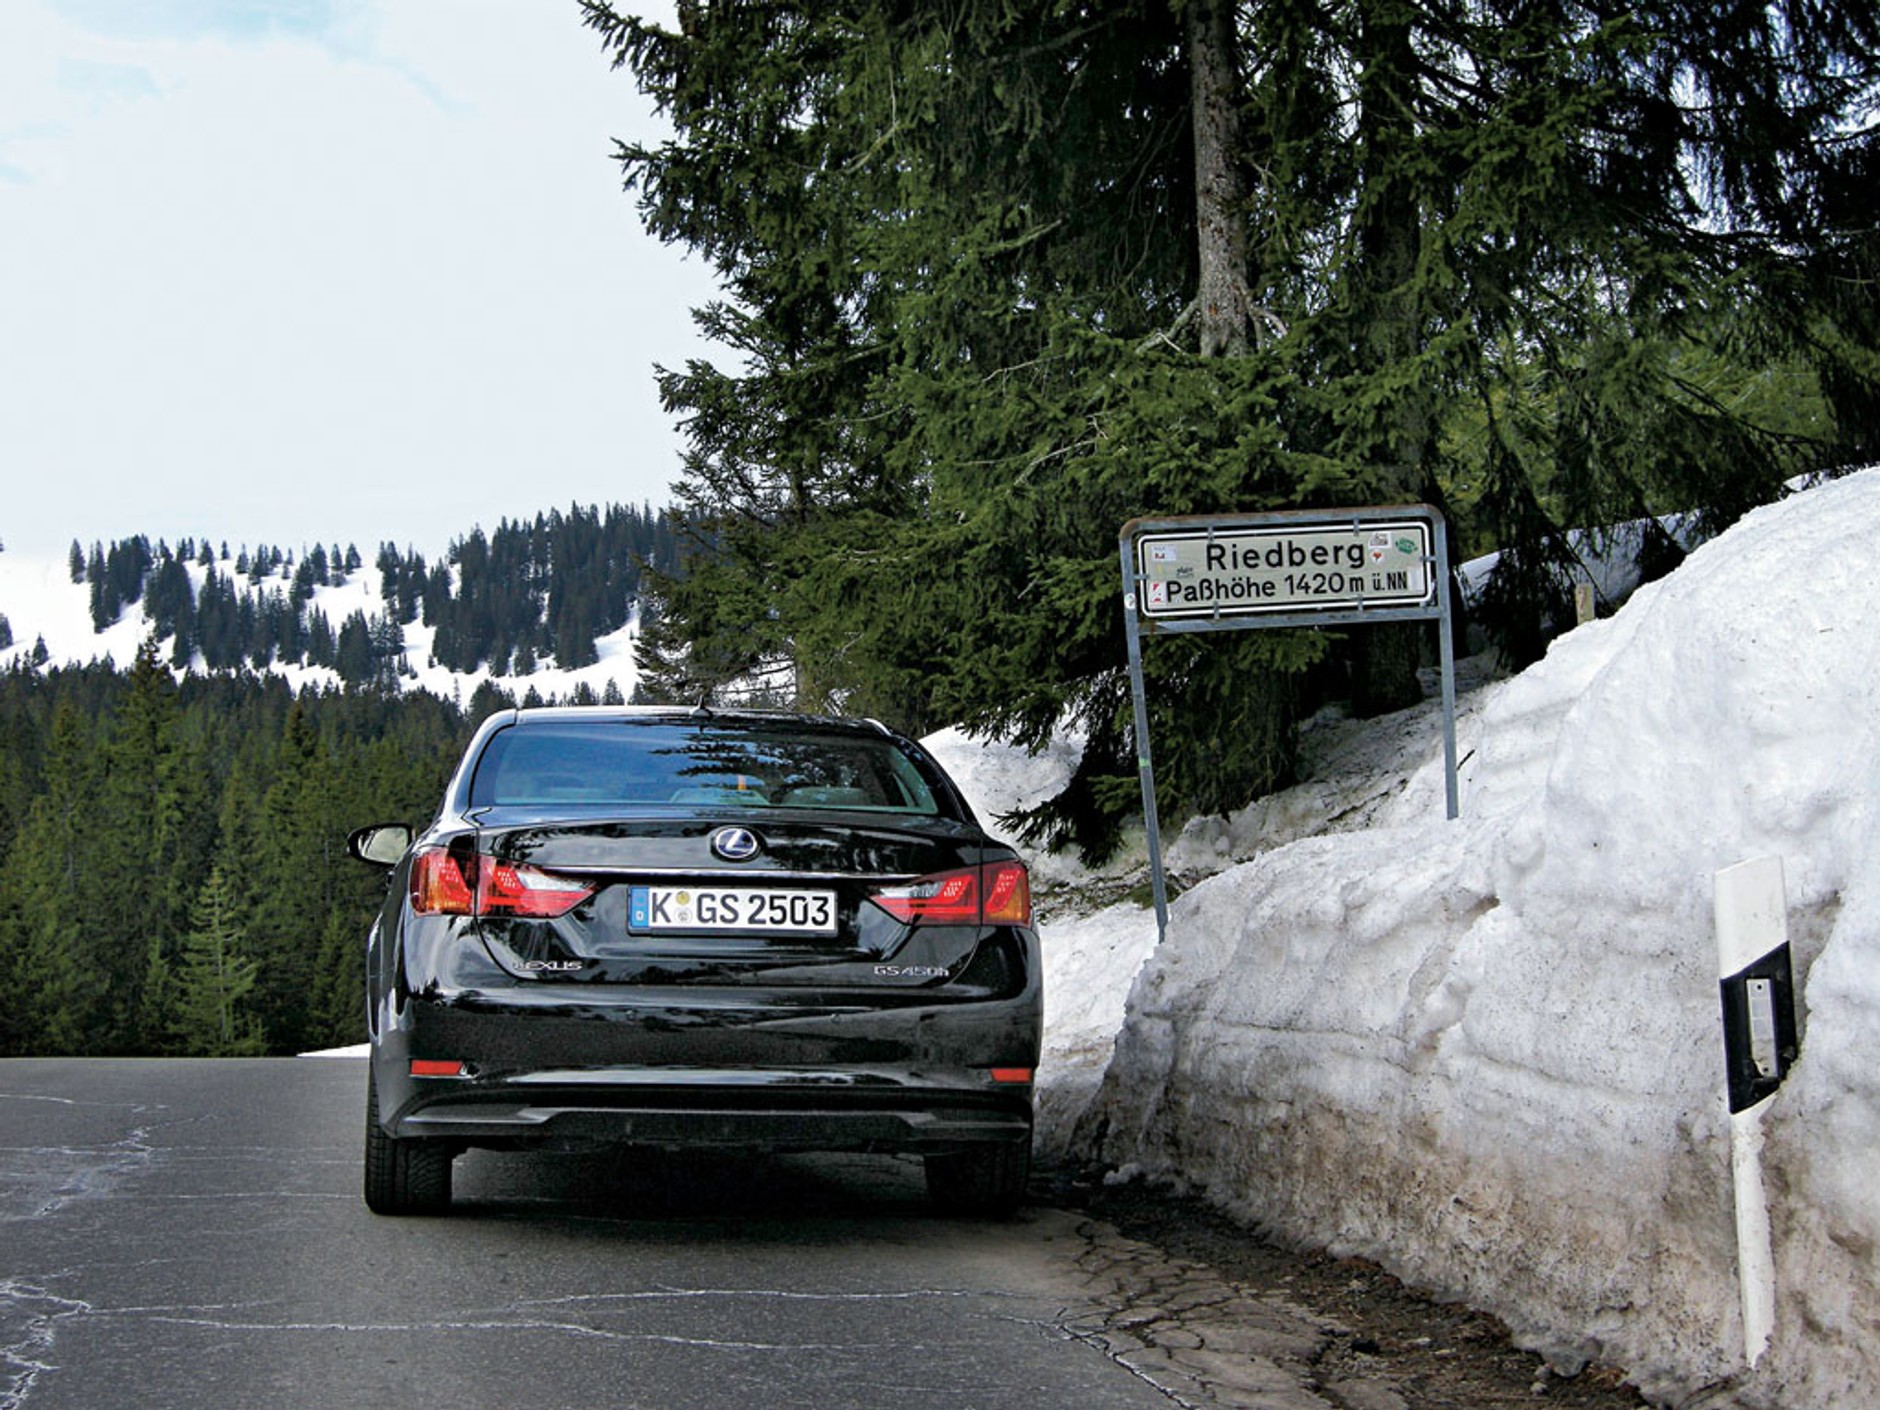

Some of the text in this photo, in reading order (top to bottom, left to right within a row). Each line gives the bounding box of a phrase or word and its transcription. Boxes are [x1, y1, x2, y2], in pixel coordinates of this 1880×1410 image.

[1206, 541, 1365, 571] Riedberg
[1166, 577, 1276, 602] Paßhöhe
[1284, 572, 1345, 596] 1420
[651, 892, 830, 926] K GS 2503
